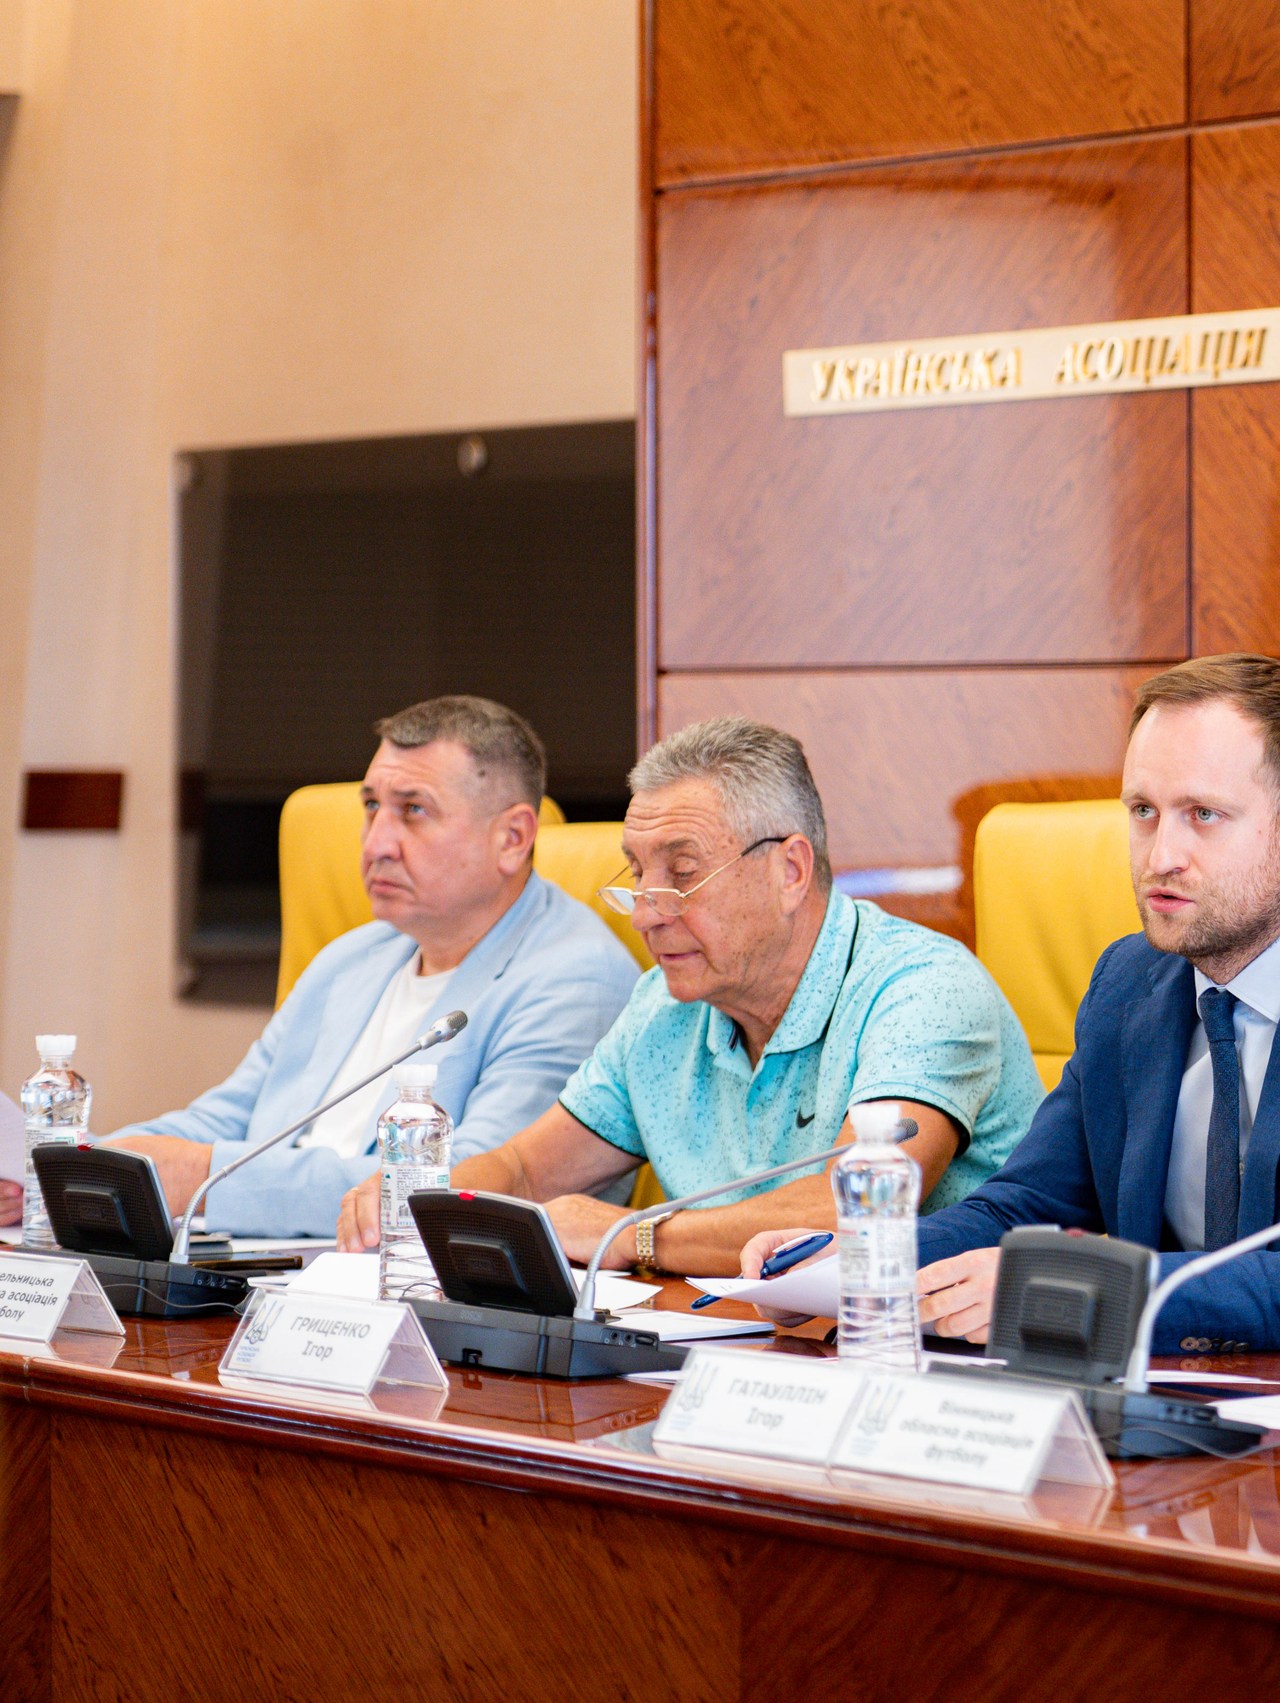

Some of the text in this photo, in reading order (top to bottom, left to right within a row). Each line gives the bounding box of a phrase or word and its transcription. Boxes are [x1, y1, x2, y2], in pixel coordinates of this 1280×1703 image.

[810, 346, 1023, 402] УКРАЇНСЬКА
[1052, 327, 1268, 384] АСОЦІАЦІЯ
[8, 1291, 58, 1306] асоціація
[290, 1316, 371, 1339] ГРИЩЕНКО
[301, 1341, 333, 1361] Ігор
[745, 1407, 785, 1430] Ігор
